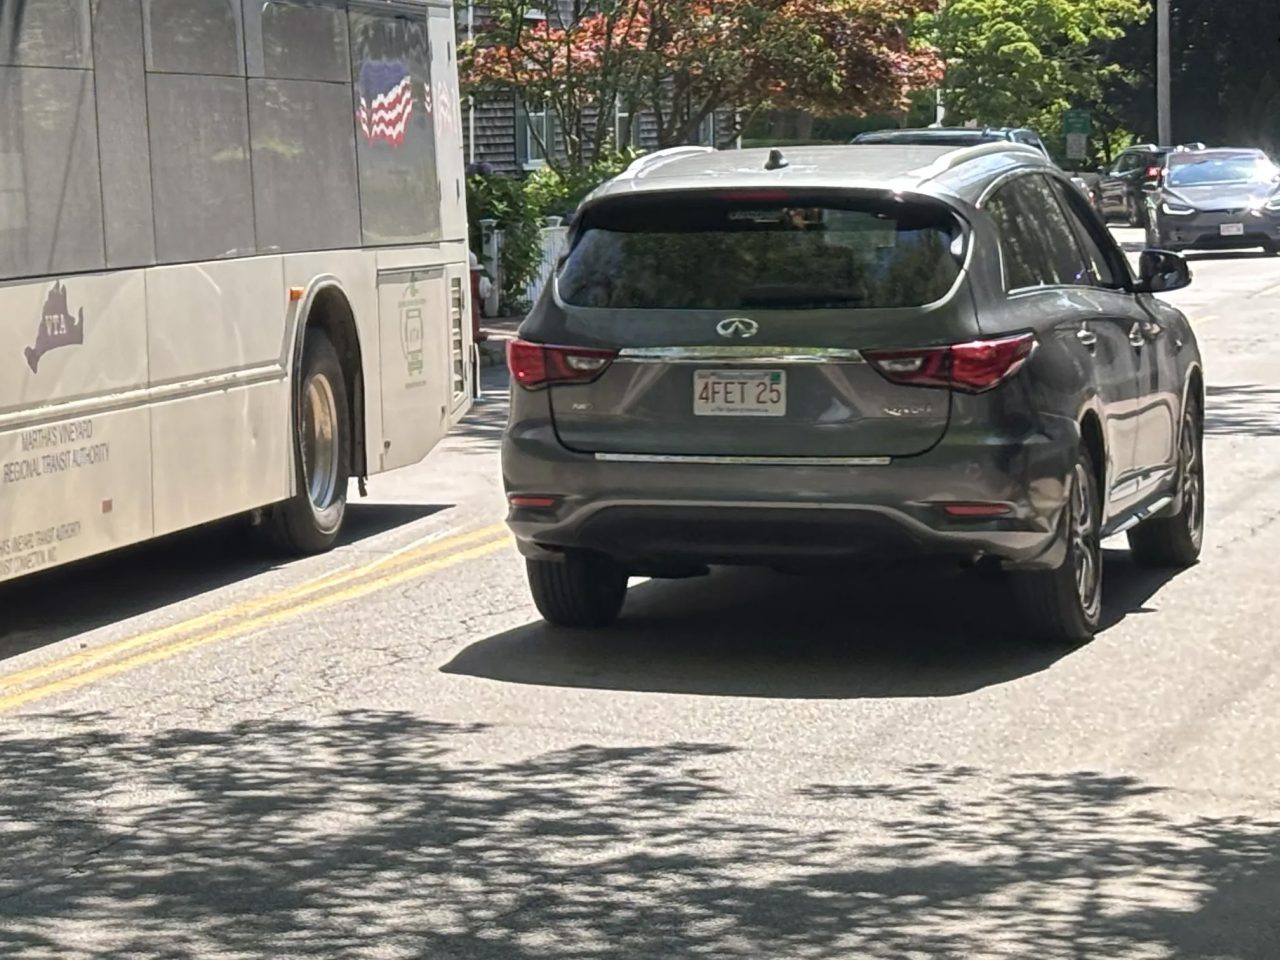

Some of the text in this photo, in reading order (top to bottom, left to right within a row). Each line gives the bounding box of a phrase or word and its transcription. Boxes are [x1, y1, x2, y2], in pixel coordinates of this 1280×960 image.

[44, 314, 67, 336] VTA
[698, 381, 782, 405] 4FET 25
[59, 419, 93, 445] VINEYARD
[3, 442, 111, 483] REGIONAL TRANSIT AUTHORITY
